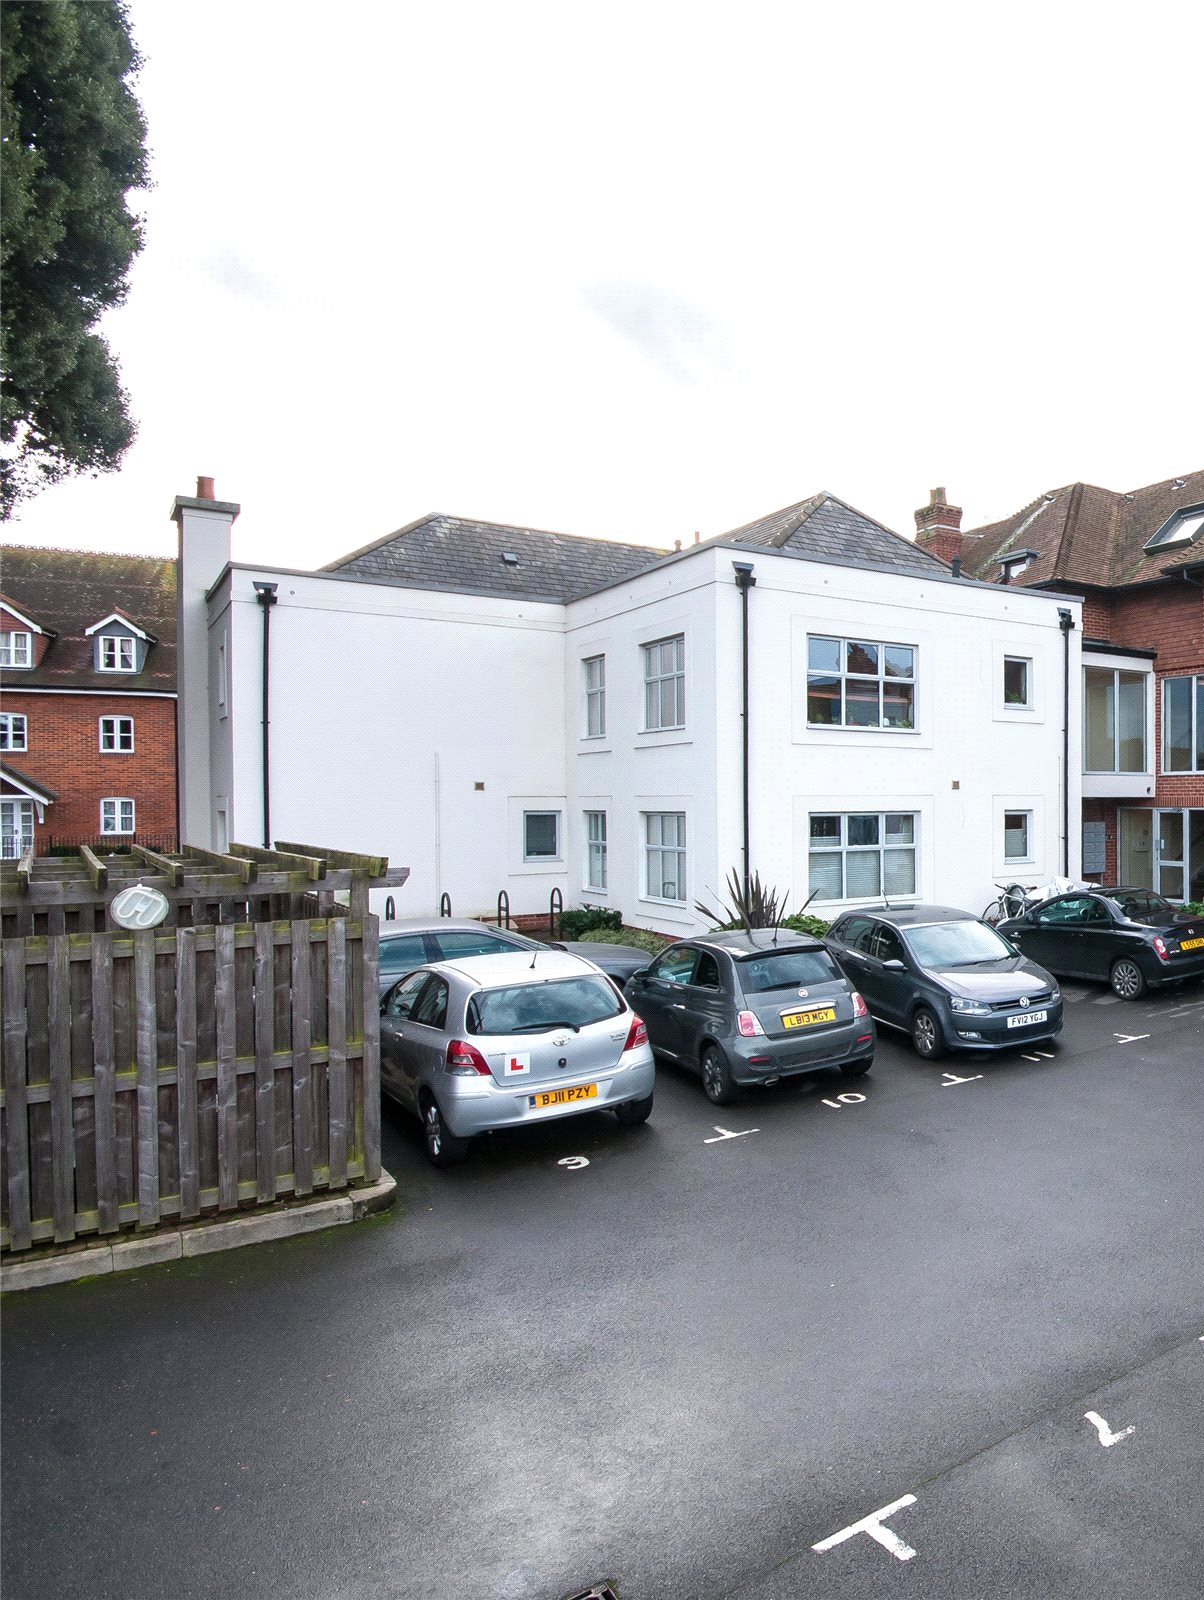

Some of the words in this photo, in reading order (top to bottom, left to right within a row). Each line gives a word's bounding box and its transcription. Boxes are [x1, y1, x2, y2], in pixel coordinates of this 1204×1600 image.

[789, 1014, 810, 1026] LB13
[812, 1011, 829, 1022] MGY
[1012, 1016, 1028, 1026] FV12
[1029, 1013, 1043, 1022] YGJ
[510, 1058, 524, 1071] L
[542, 1091, 565, 1106] BJ11
[568, 1086, 591, 1101] PZY
[821, 1093, 867, 1109] 10
[557, 1156, 590, 1170] 9
